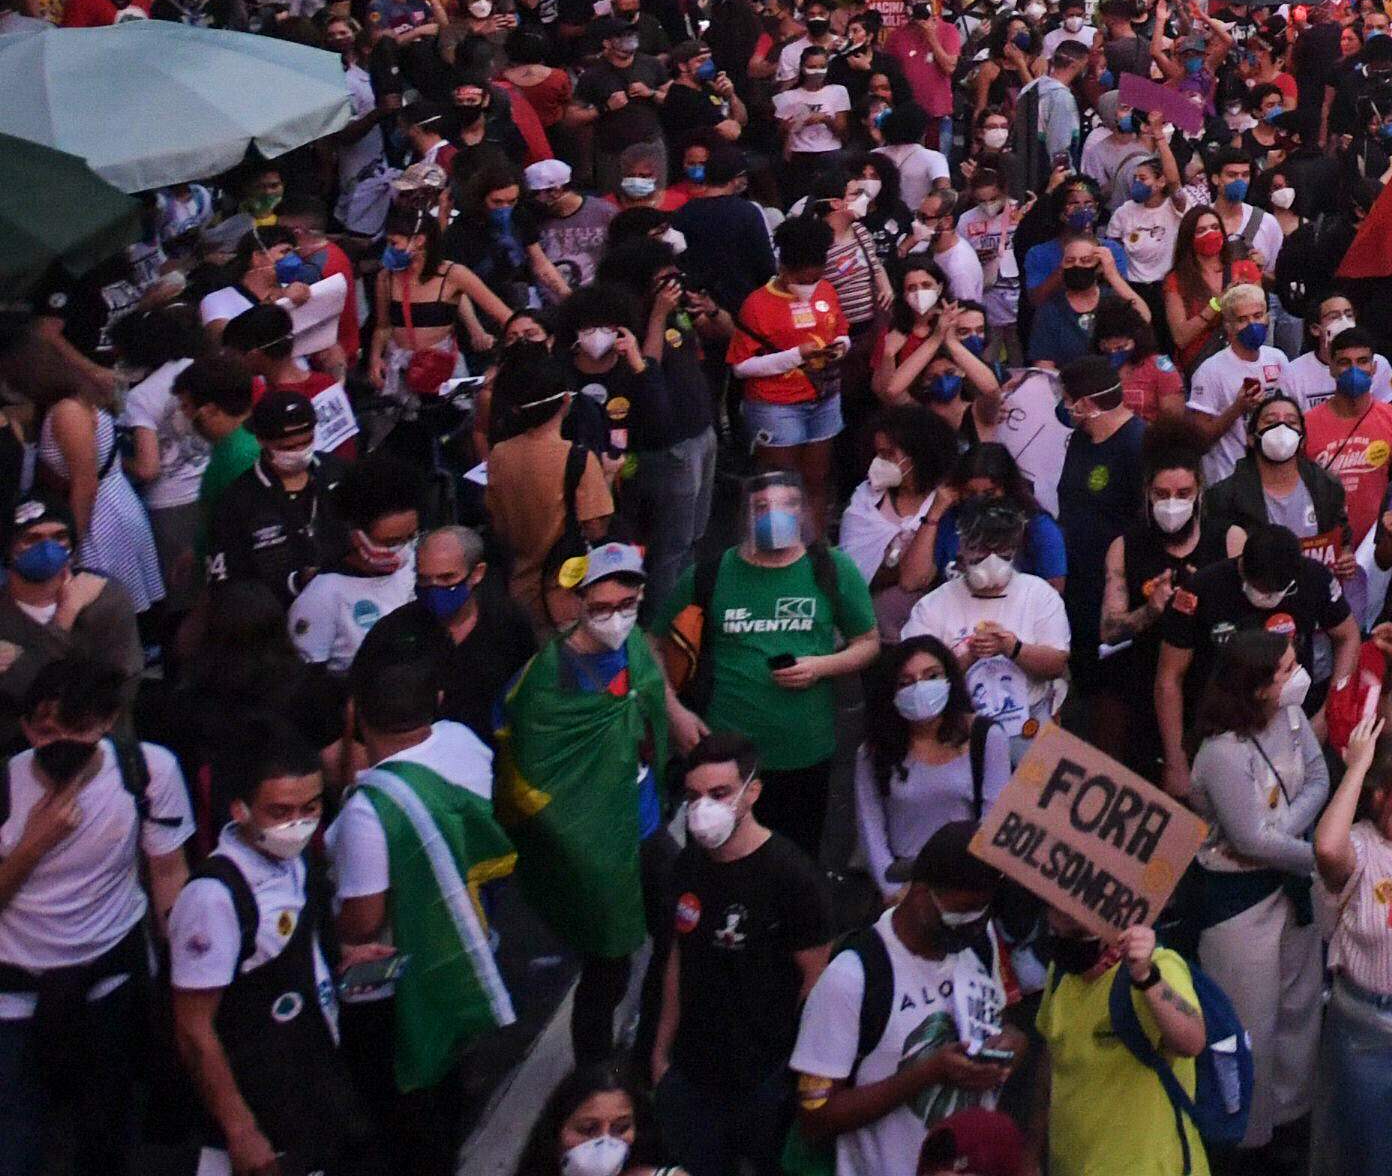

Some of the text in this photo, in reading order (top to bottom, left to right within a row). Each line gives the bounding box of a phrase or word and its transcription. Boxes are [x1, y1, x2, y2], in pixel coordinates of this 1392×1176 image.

[723, 619, 814, 632] INVENTAR
[725, 608, 752, 620] RE-
[1038, 757, 1173, 864] FORA
[992, 810, 1151, 931] BOLSONARO
